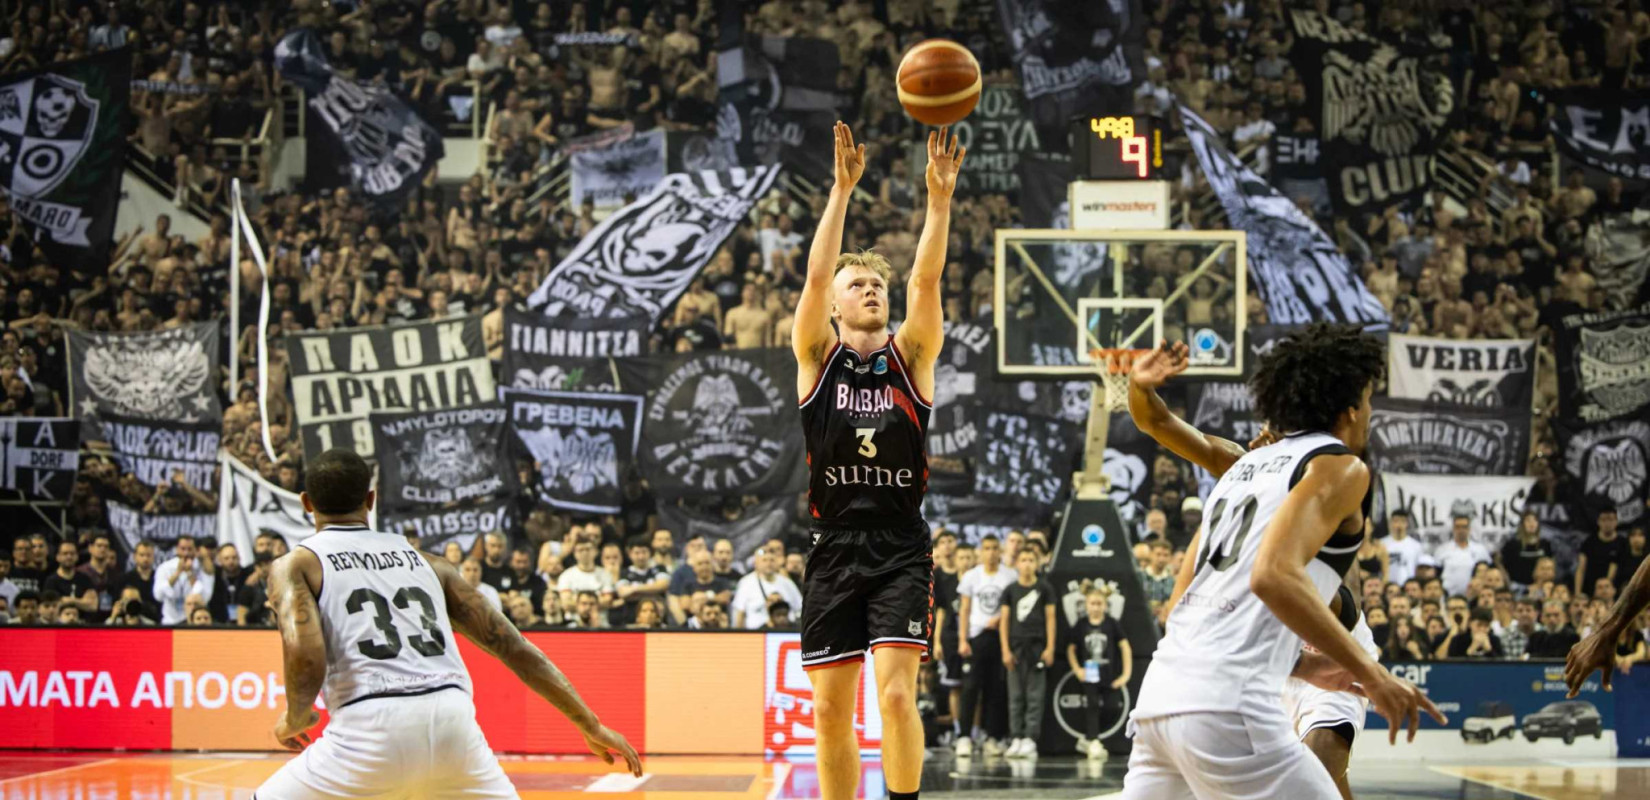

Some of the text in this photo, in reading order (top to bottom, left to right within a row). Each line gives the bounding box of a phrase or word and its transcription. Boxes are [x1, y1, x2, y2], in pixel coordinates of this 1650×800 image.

[1122, 136, 1147, 178] 9
[1406, 344, 1525, 373] VERIA
[836, 383, 895, 413] BILBAO
[512, 401, 626, 430] ΓΡΕΒΕΝΑ
[855, 427, 878, 459] 3
[402, 550, 424, 571] JR
[345, 586, 446, 660] 33
